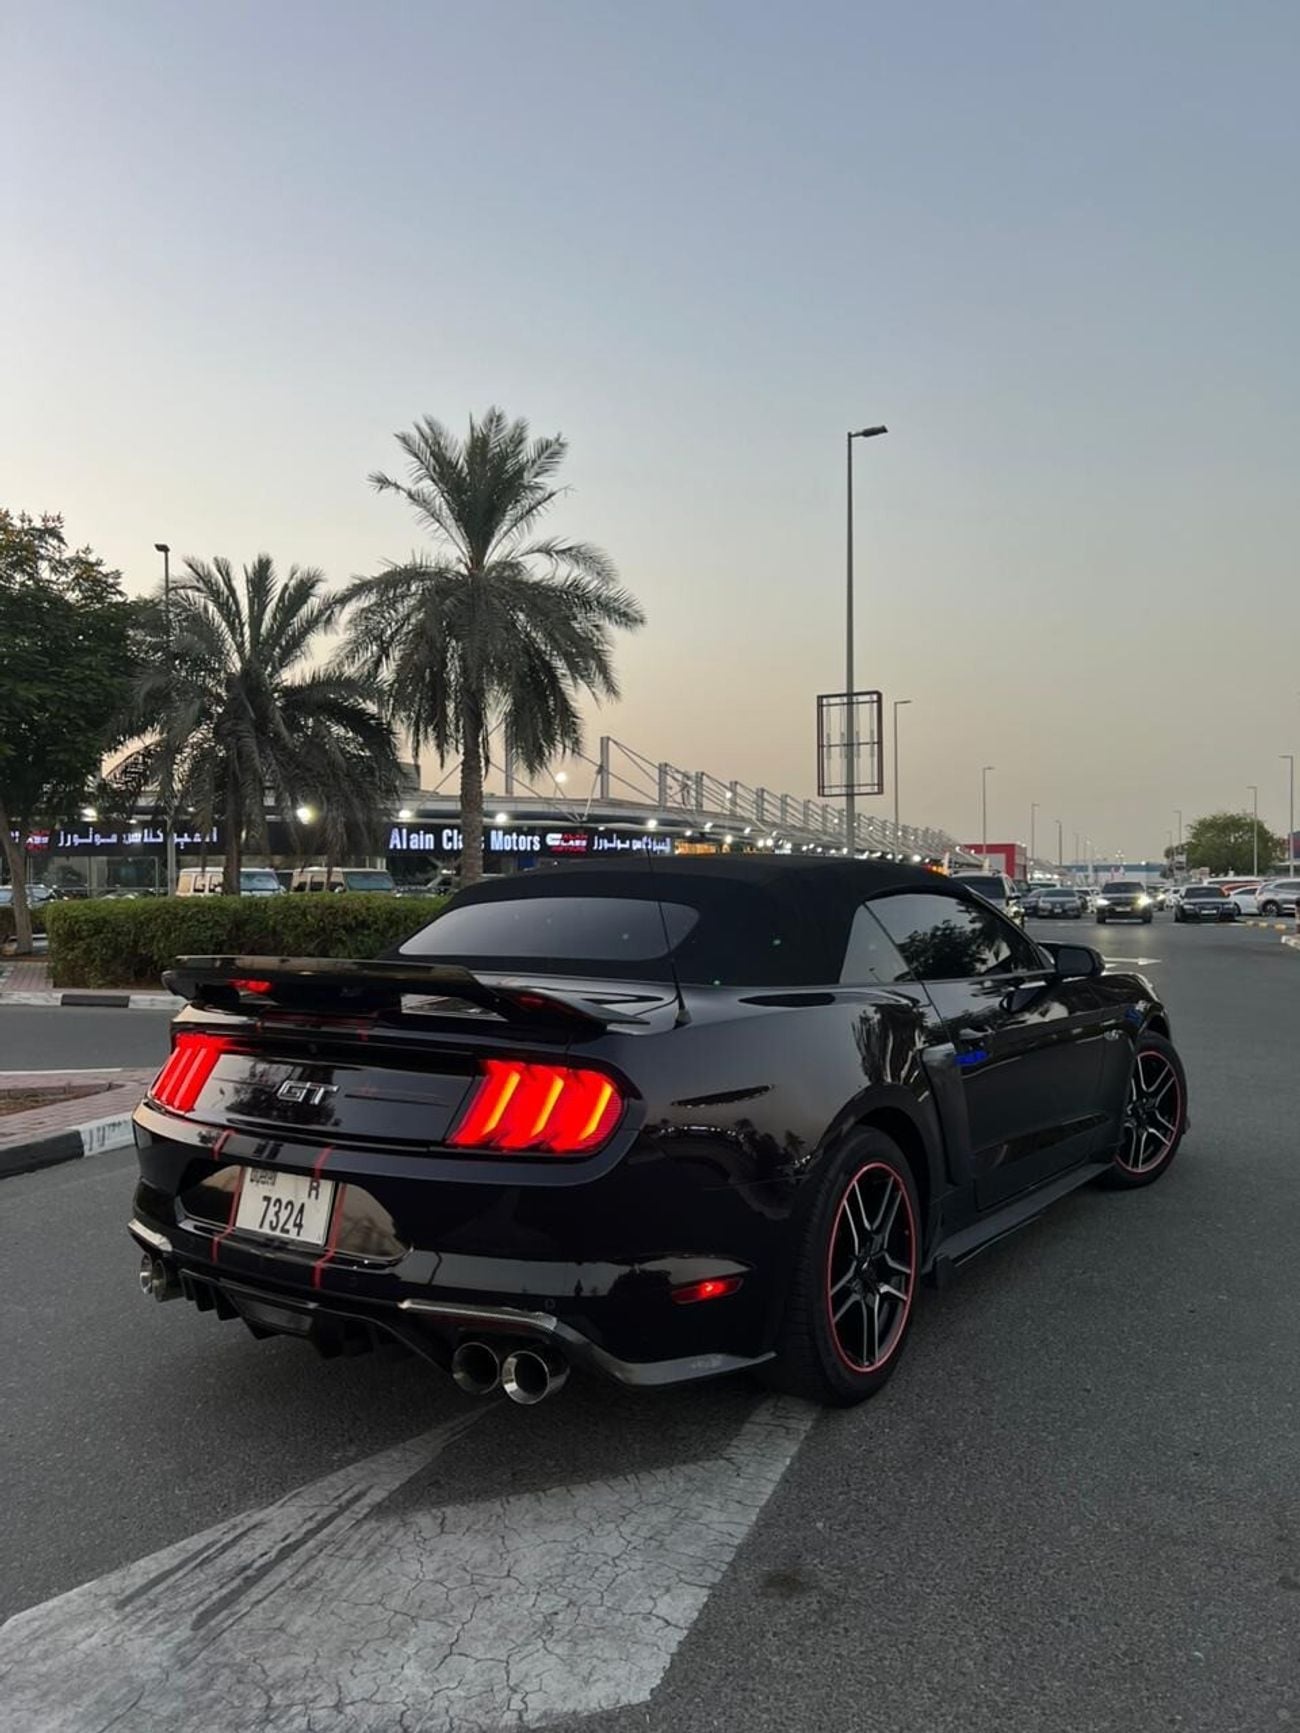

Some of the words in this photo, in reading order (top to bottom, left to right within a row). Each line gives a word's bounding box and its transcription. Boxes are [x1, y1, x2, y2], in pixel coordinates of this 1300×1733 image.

[389, 828, 434, 850] Alain
[490, 830, 541, 851] Motors
[277, 1080, 339, 1104] GT
[259, 1195, 305, 1237] 7324
